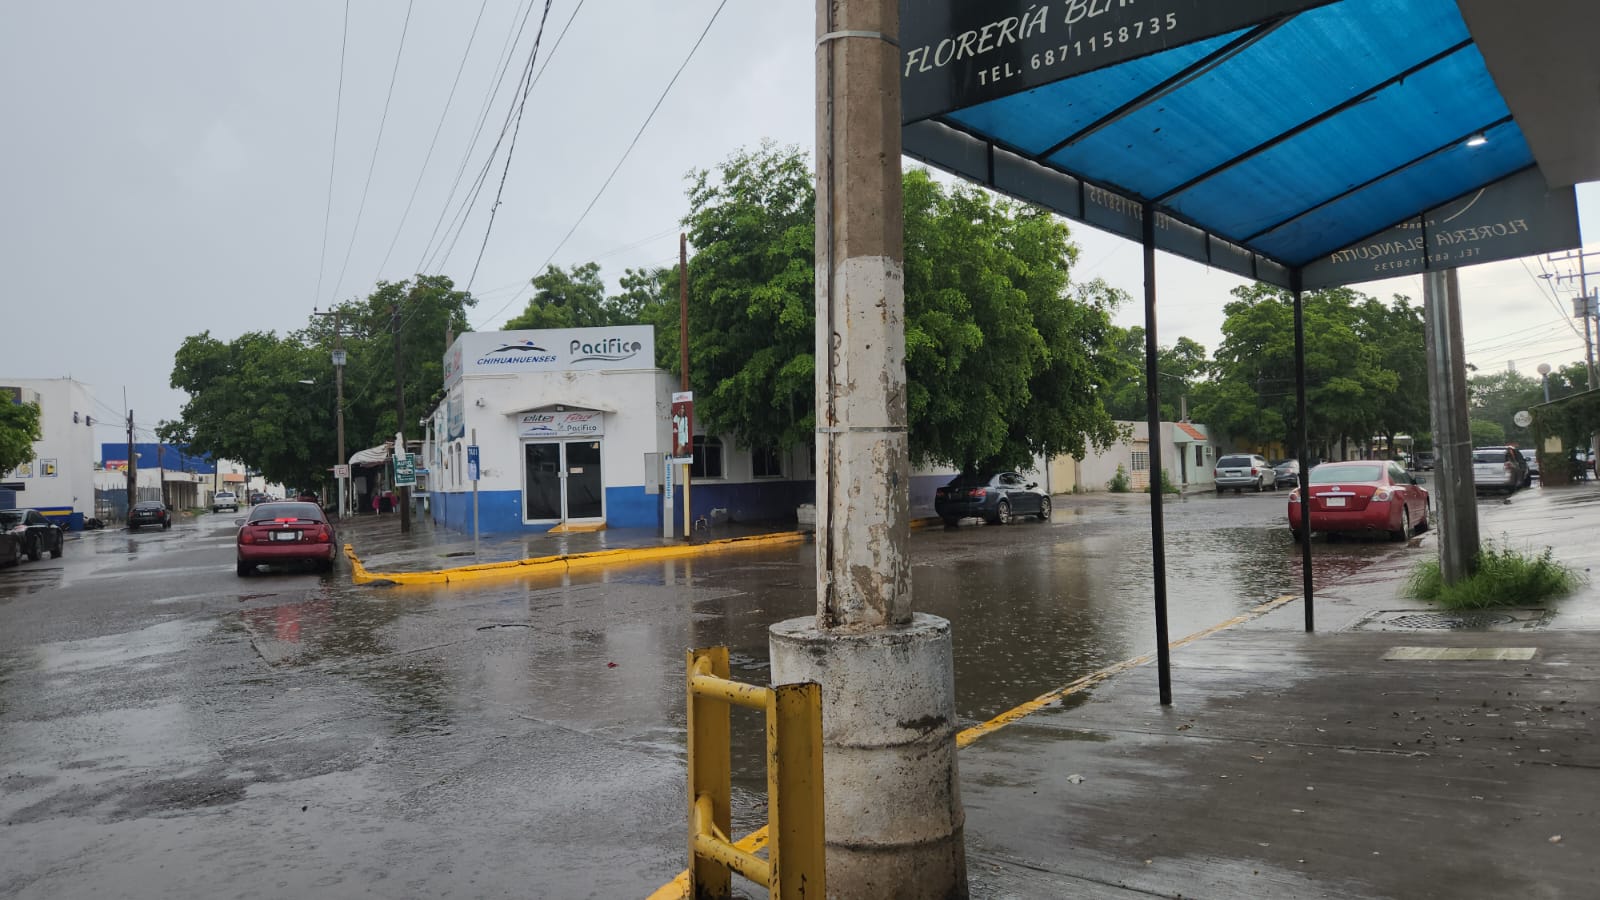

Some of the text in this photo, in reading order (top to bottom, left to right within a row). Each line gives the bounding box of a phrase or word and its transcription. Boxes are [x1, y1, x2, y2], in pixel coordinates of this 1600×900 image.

[904, 5, 1049, 77] FLORERÍA
[978, 12, 1178, 86] TEL. 6871158735
[477, 355, 557, 365] CHIHUAHUENSES
